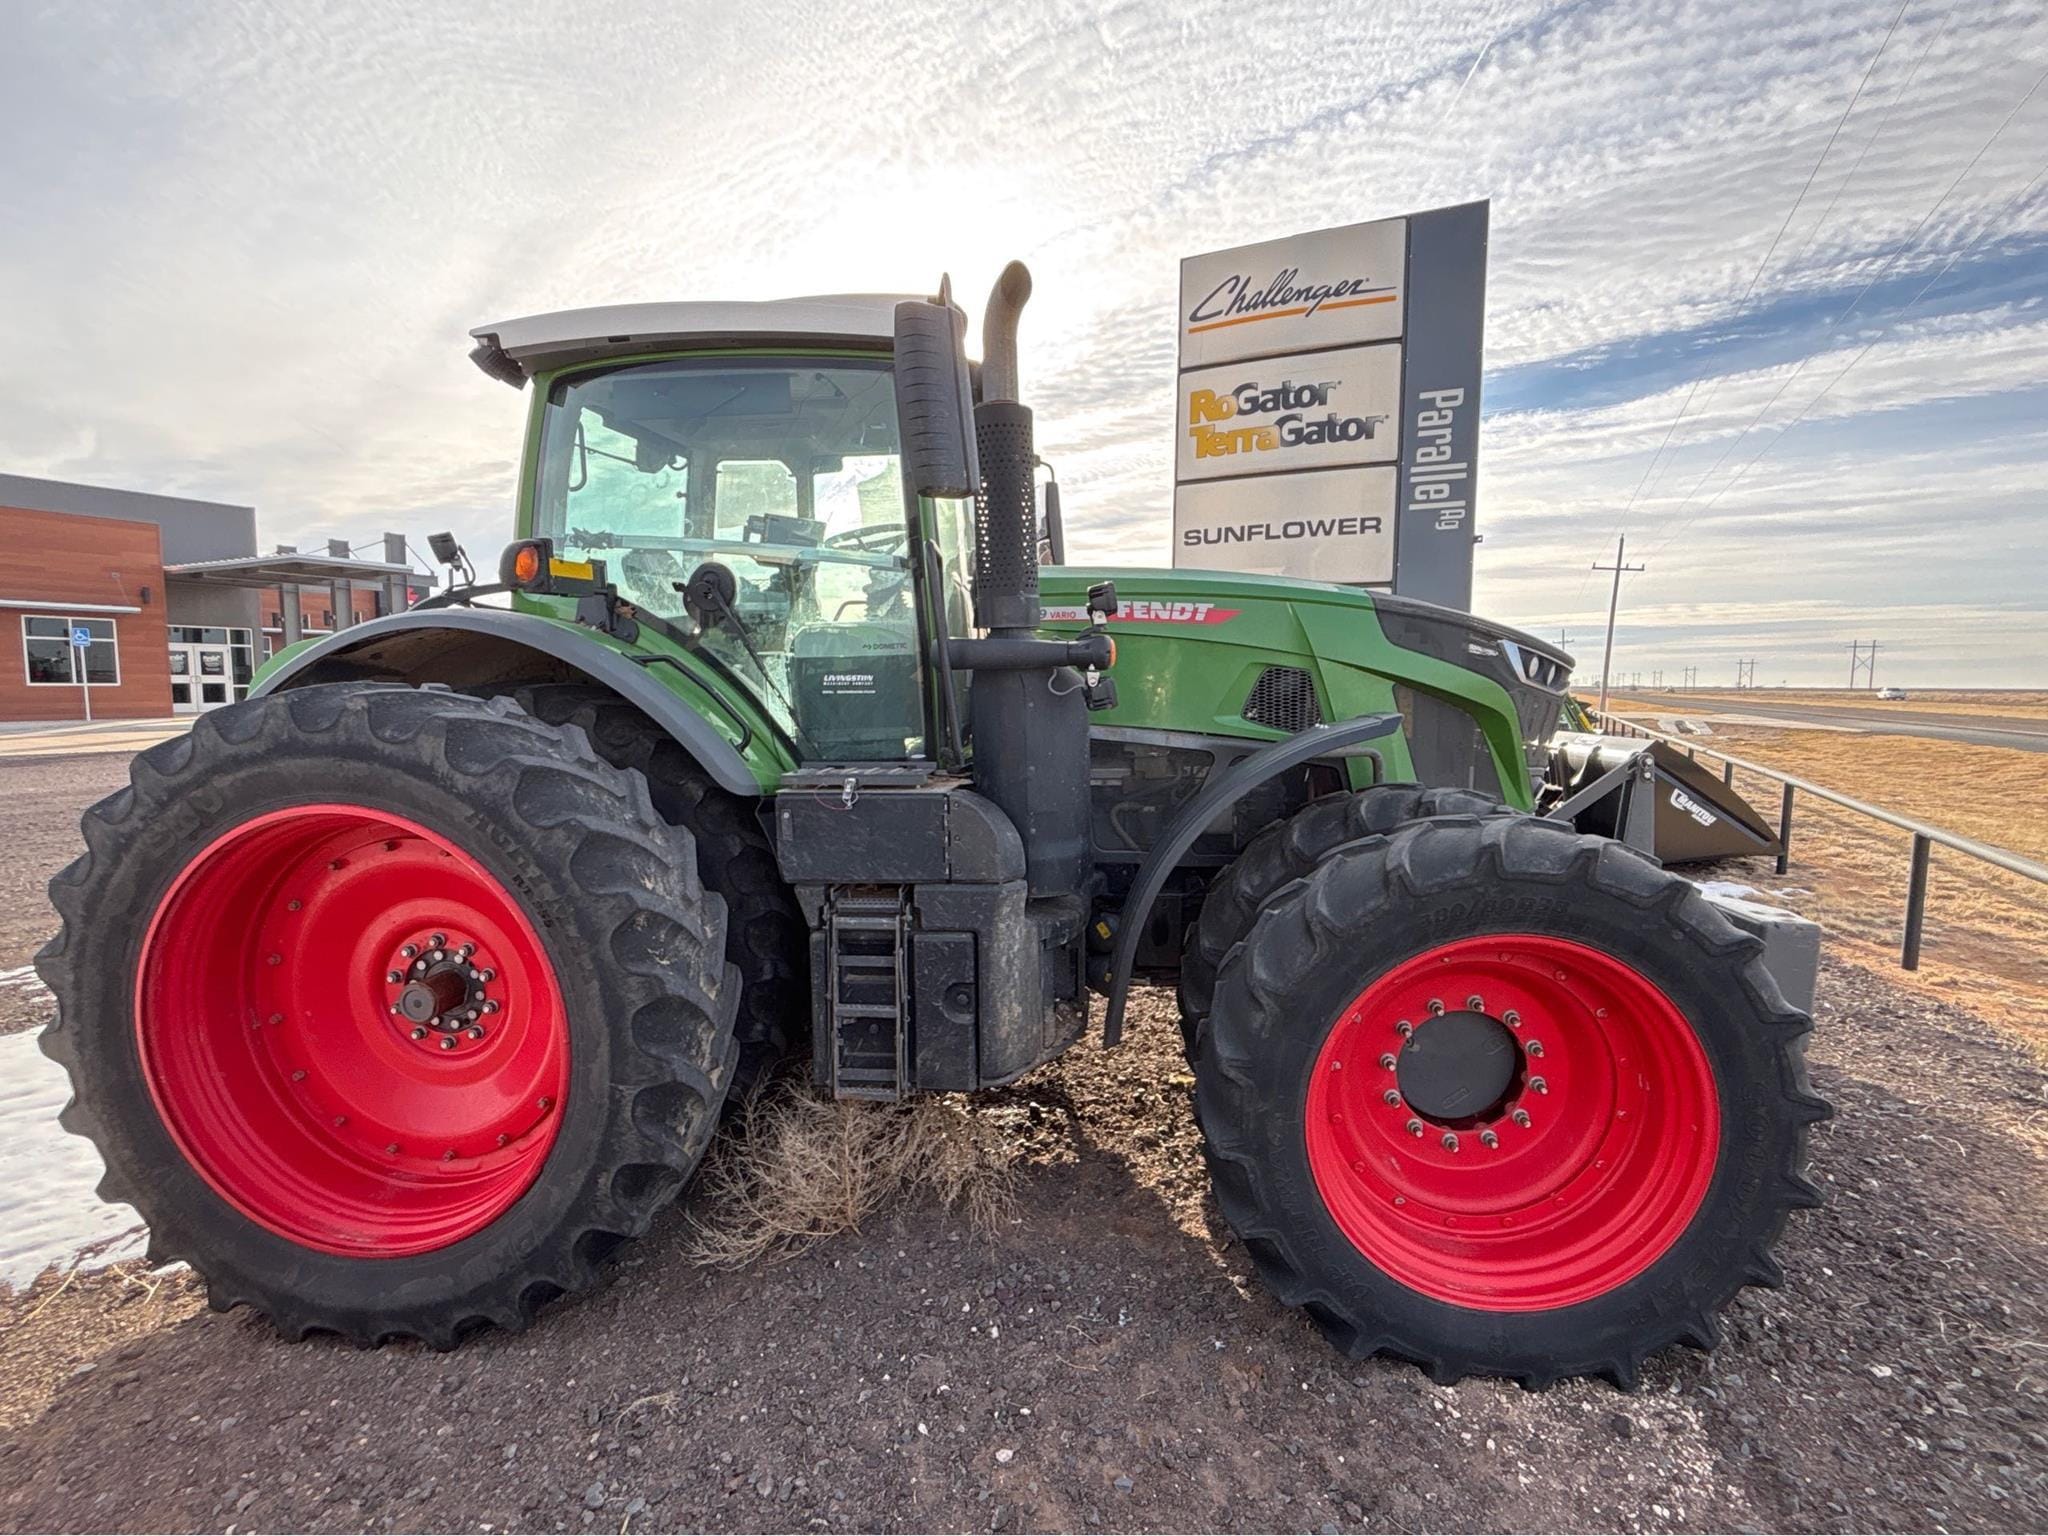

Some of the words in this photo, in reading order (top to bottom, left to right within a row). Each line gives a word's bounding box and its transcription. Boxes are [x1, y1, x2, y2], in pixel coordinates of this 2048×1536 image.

[1188, 268, 1397, 318] Challenger
[1189, 380, 1338, 425] RoGator
[1189, 413, 1385, 459] TerraGator
[1409, 388, 1468, 511] Parallel
[1183, 516, 1382, 546] SUNFLOWER
[1435, 509, 1466, 531] Ag
[1050, 610, 1077, 619] VARIO
[1117, 600, 1215, 621] FENDT
